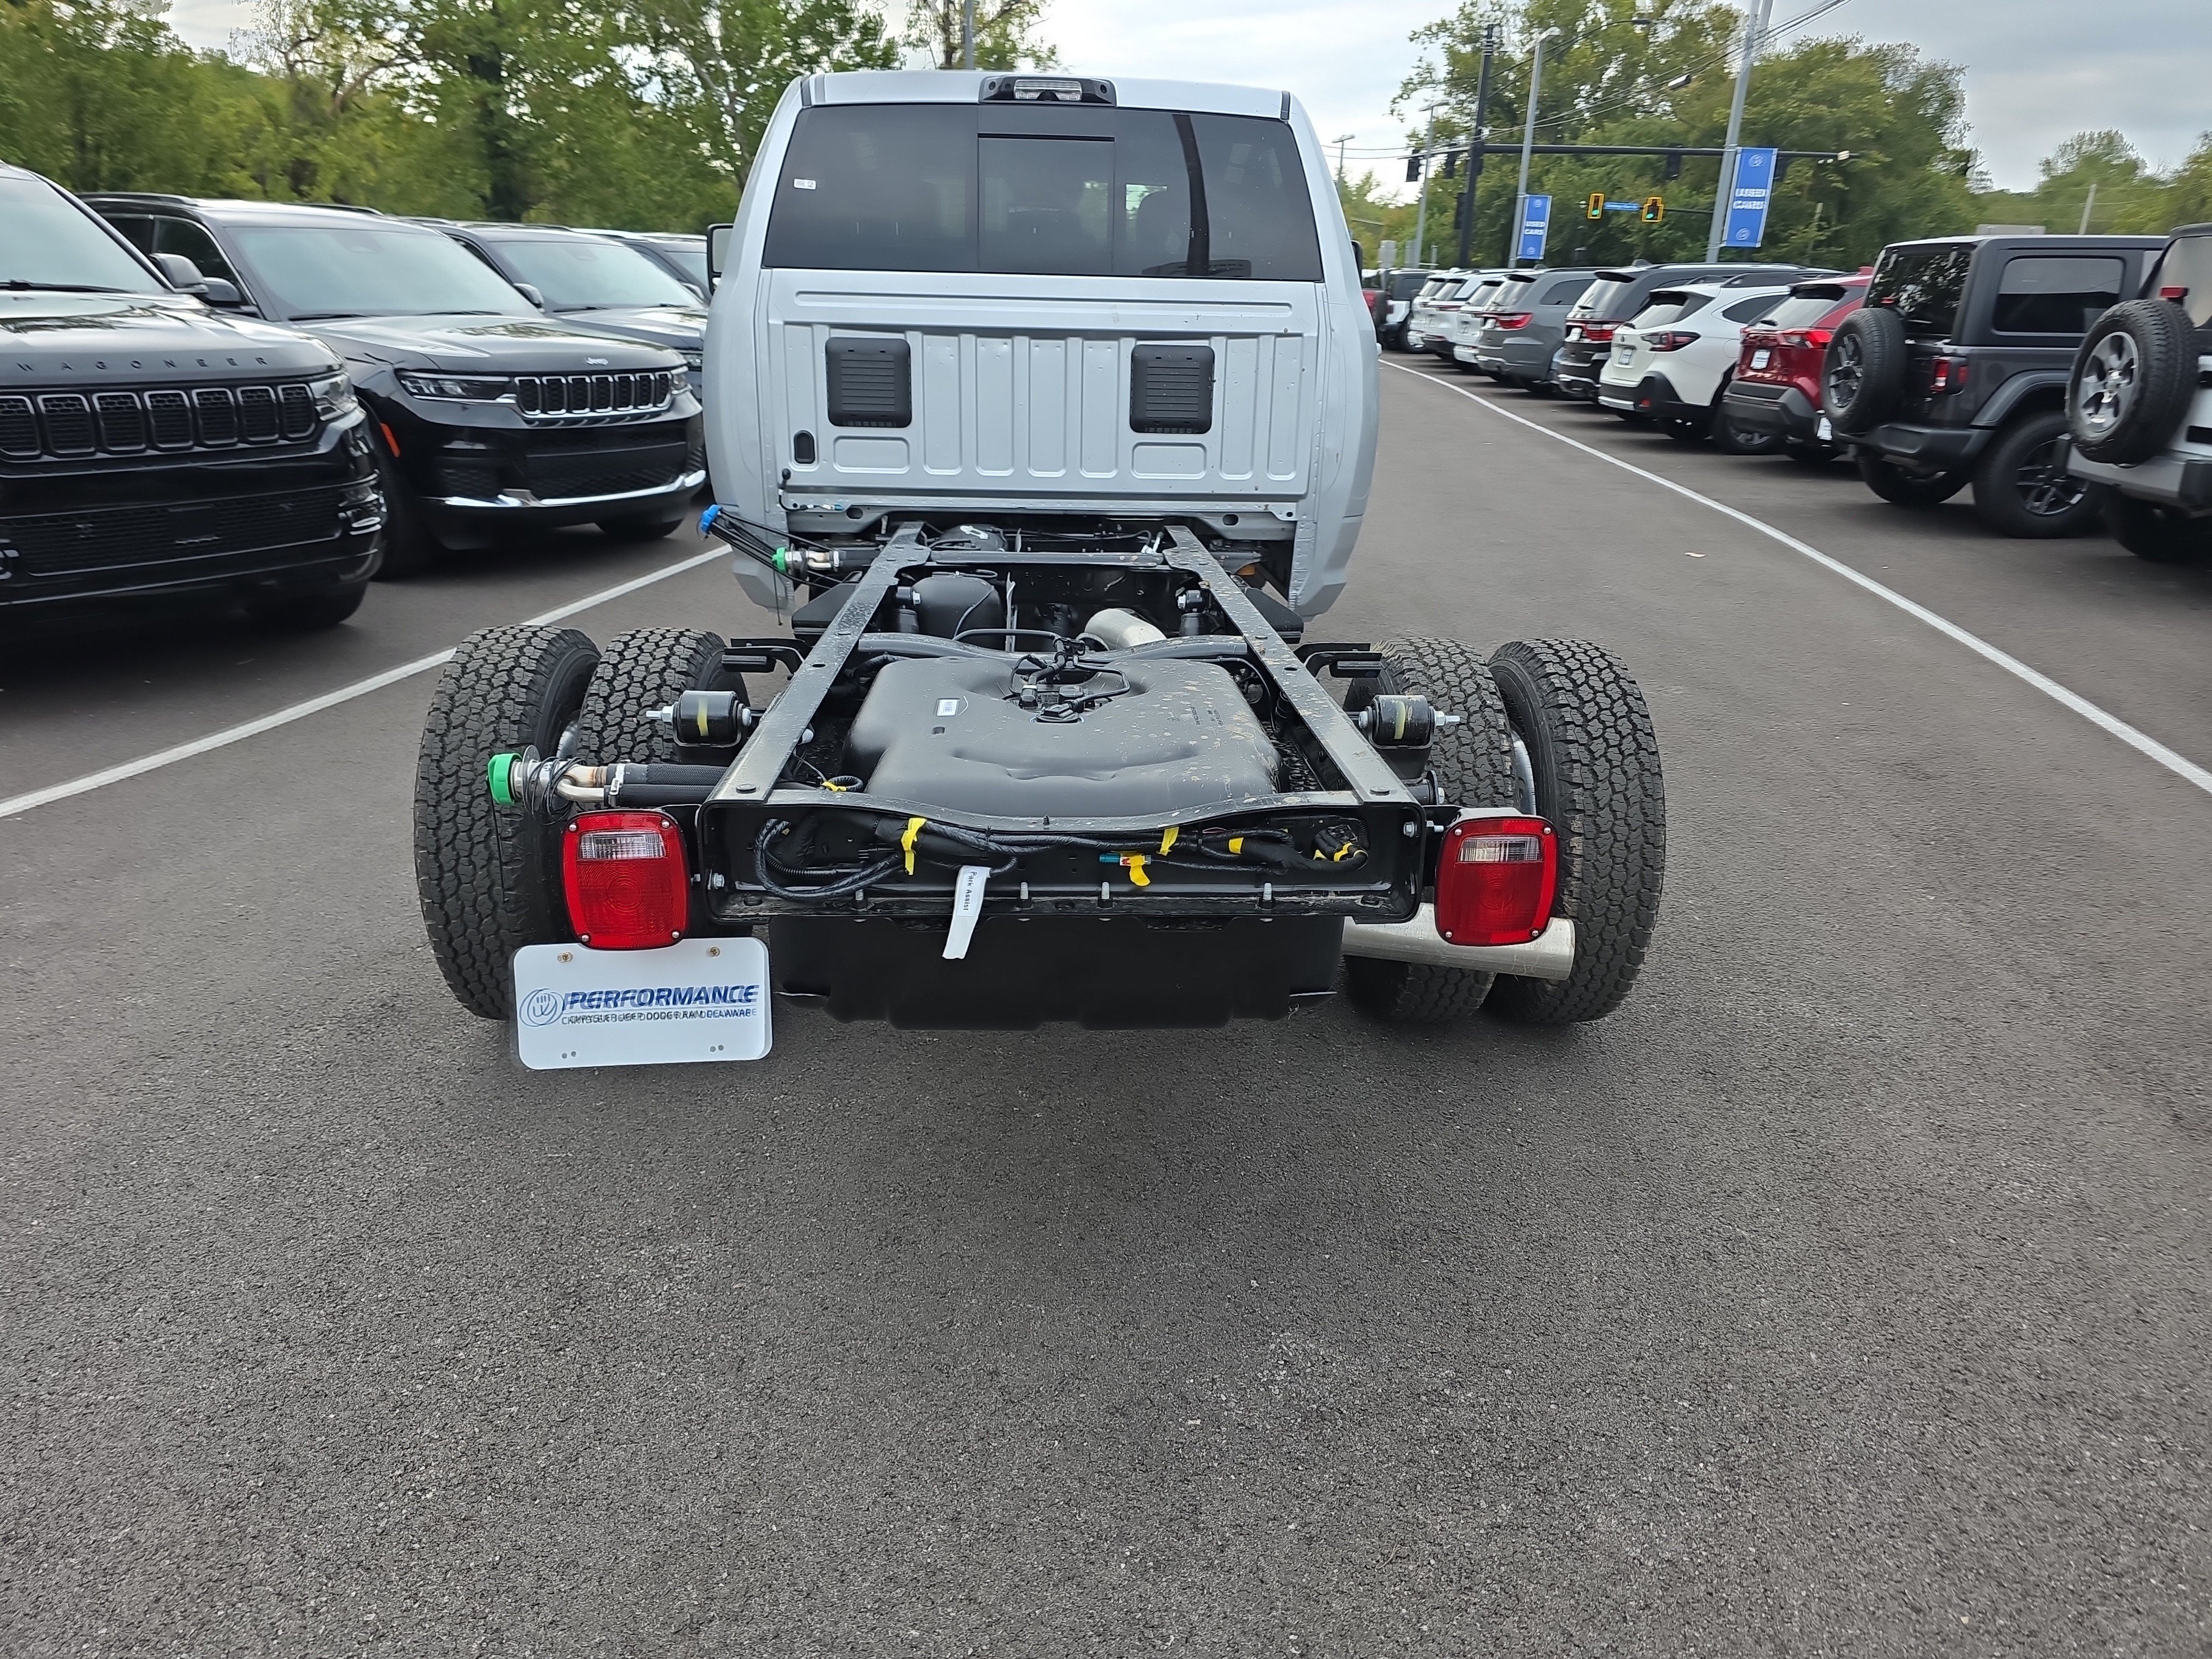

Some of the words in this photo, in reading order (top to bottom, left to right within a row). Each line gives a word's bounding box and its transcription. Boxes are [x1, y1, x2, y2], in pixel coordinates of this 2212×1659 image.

[1735, 188, 1769, 197] USED
[16, 357, 269, 372] WAGONEER
[967, 871, 978, 887] Park
[963, 889, 973, 910] Assist
[562, 985, 760, 1012] PERFORMANCE
